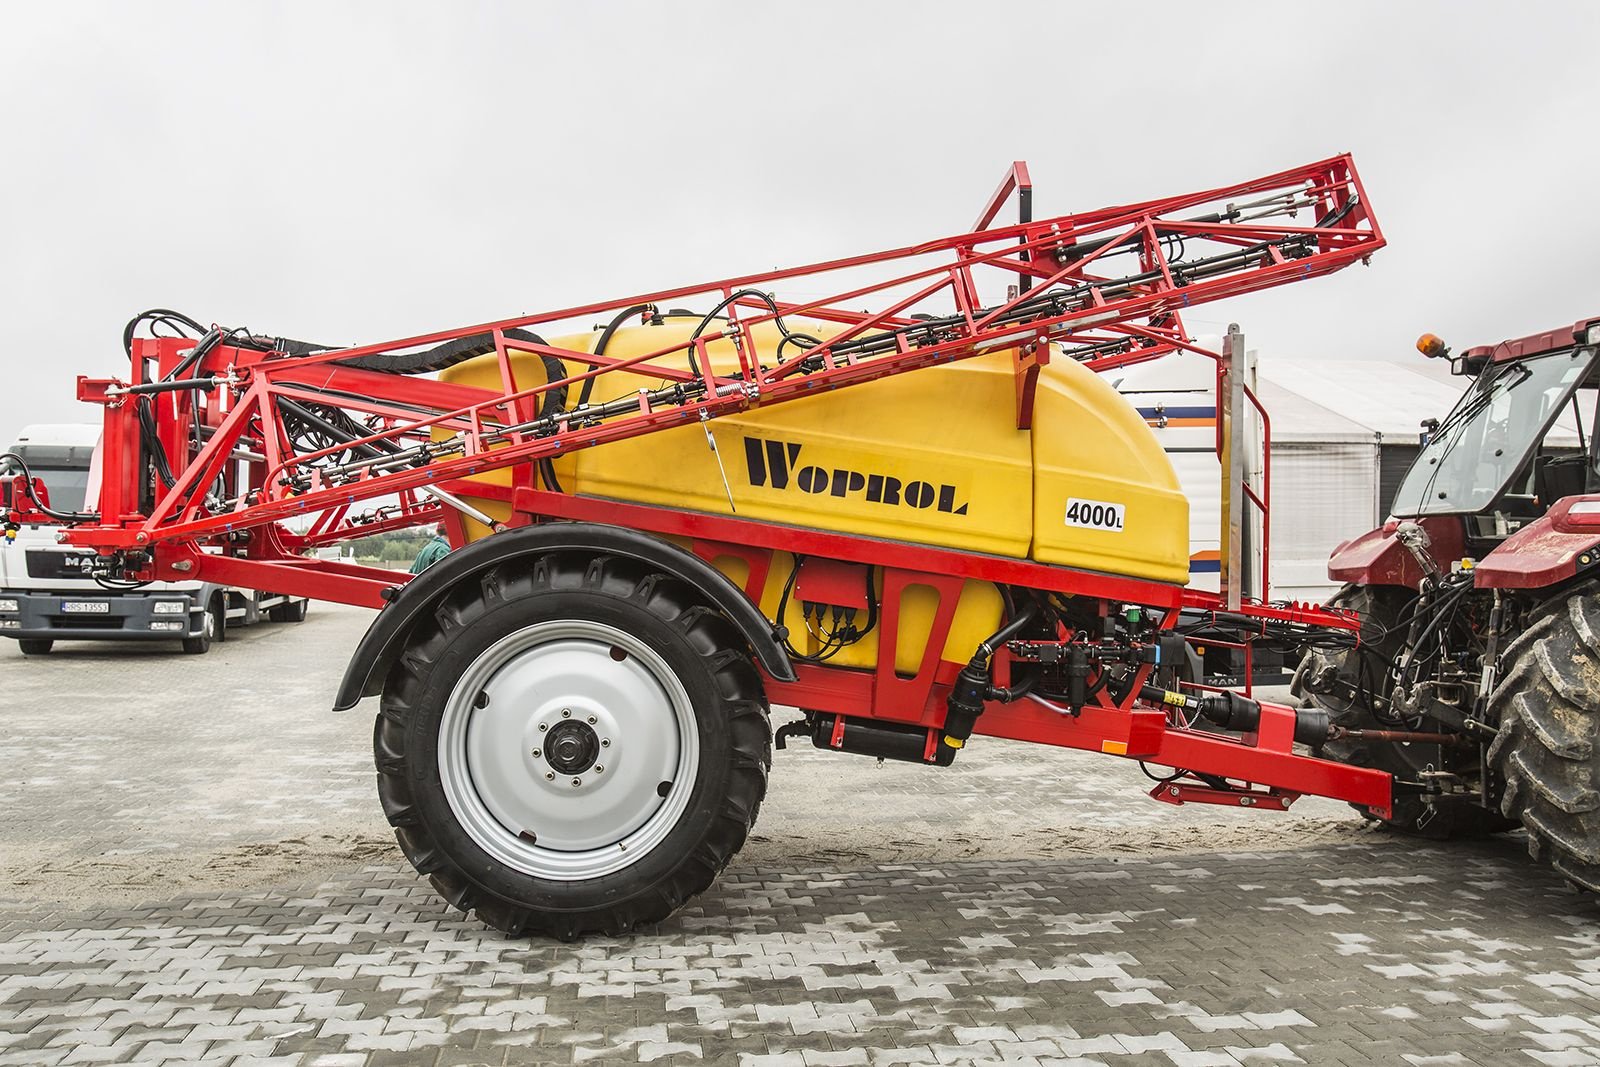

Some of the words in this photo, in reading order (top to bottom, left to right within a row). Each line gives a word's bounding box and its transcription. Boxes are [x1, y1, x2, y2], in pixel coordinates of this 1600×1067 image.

[743, 436, 969, 516] WOPROL
[1066, 502, 1123, 529] 4000L
[1208, 677, 1238, 685] MAN
